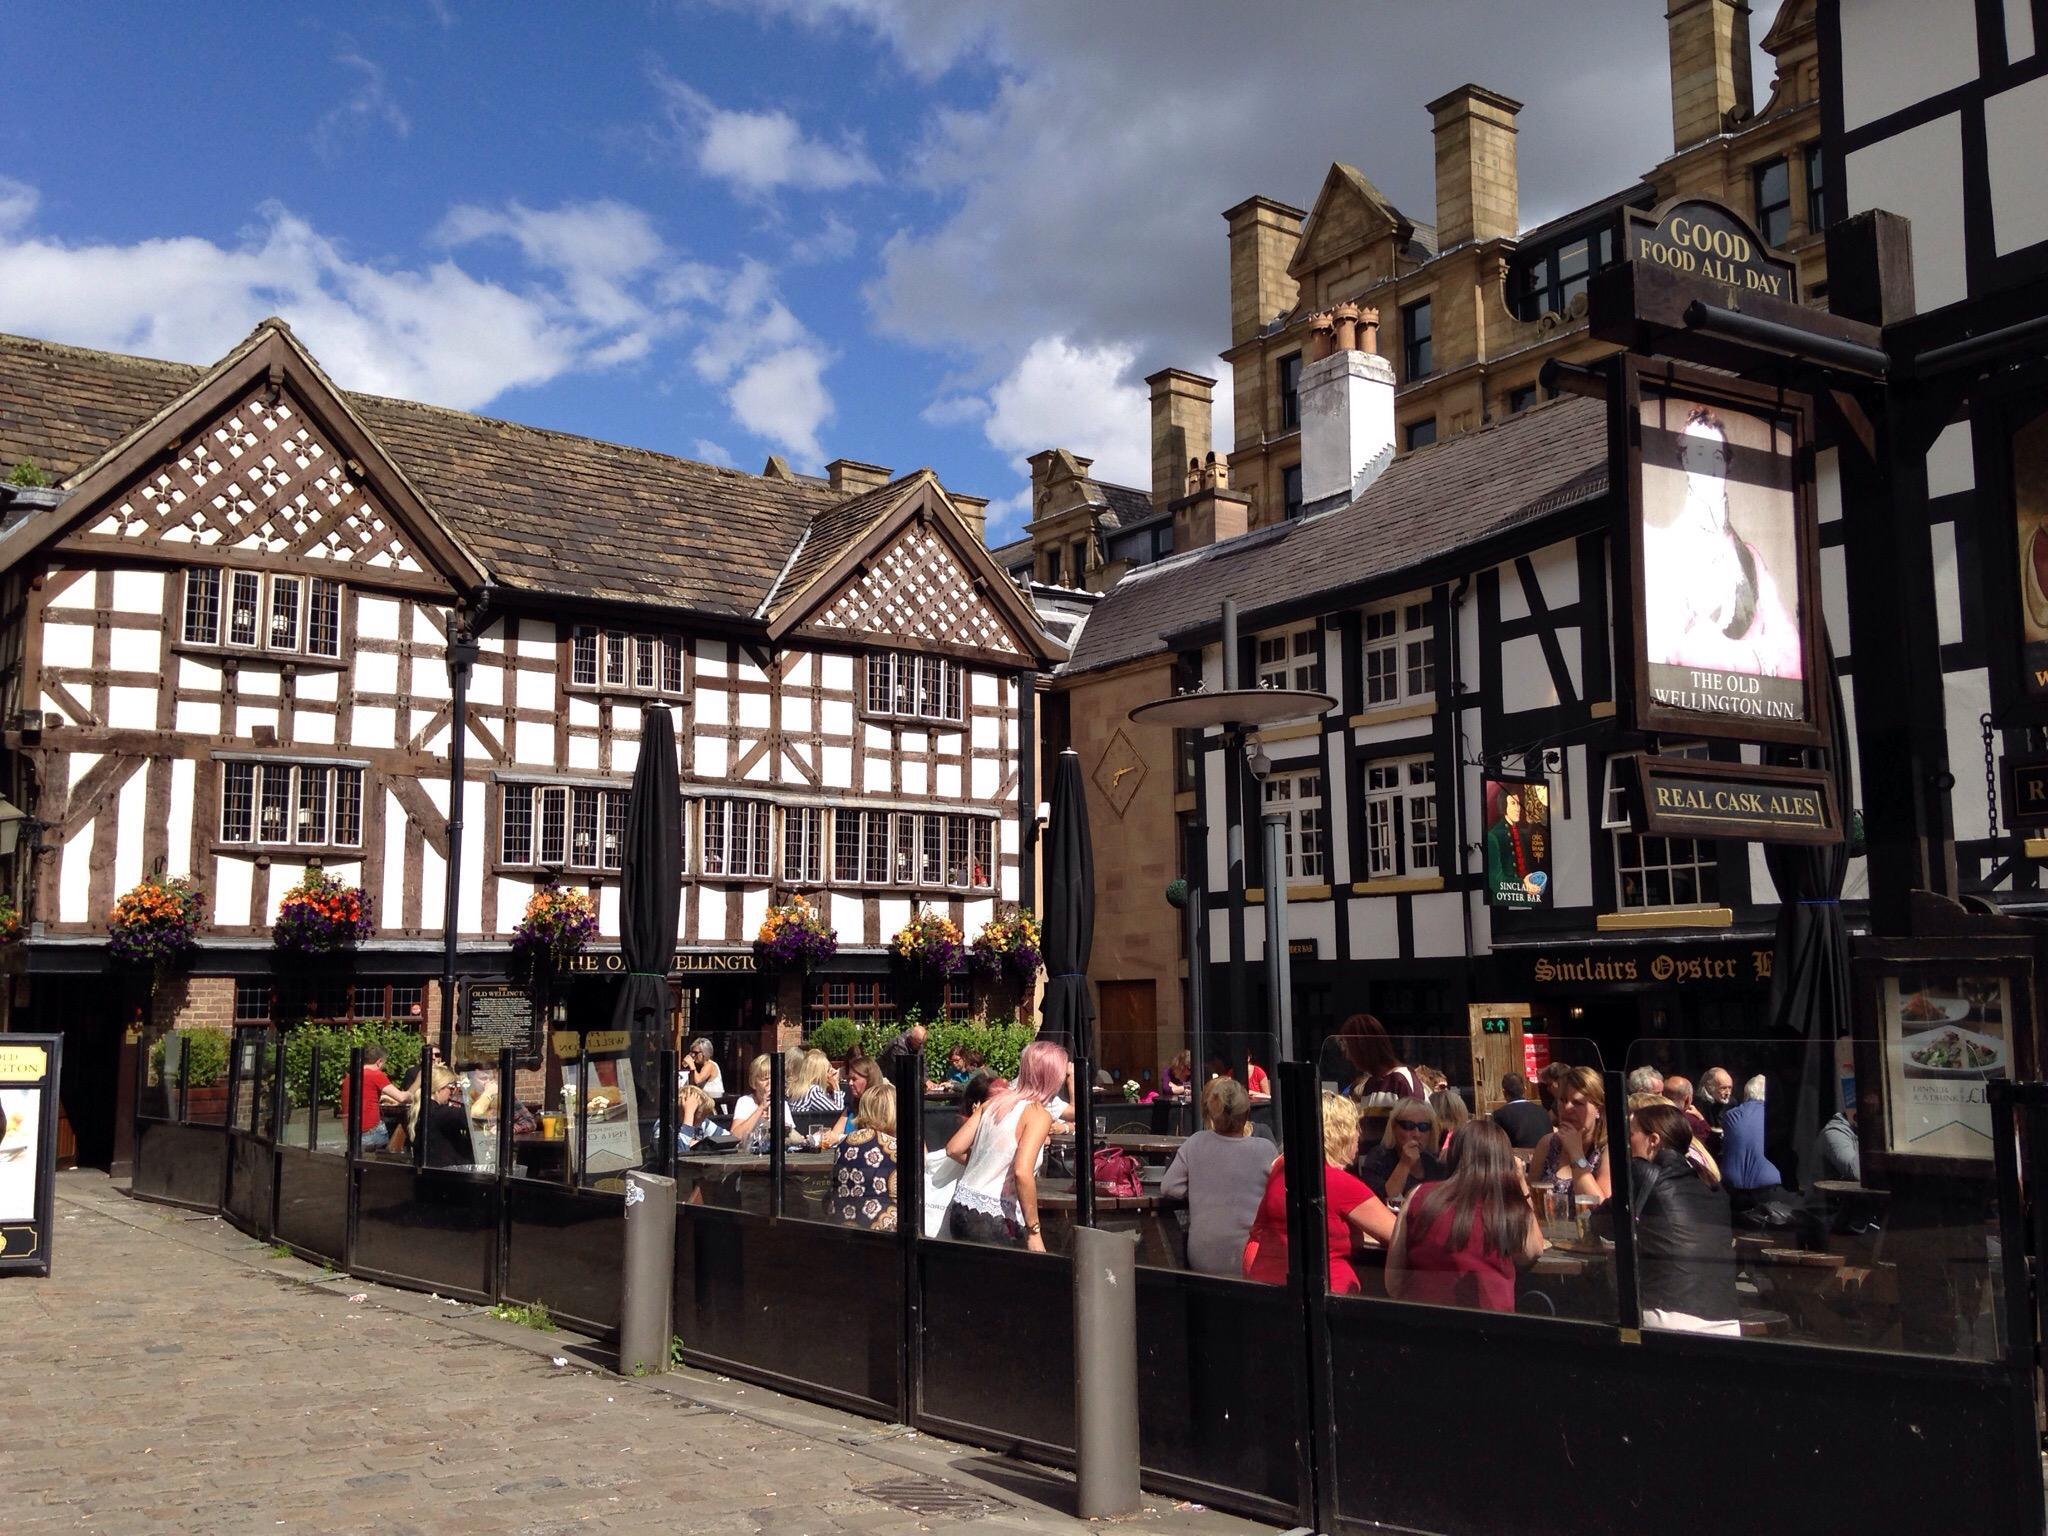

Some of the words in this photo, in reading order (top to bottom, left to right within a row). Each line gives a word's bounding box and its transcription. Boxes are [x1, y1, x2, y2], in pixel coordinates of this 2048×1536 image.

[1670, 217, 1750, 263] GOOD
[1640, 238, 1696, 272] FOOD
[1701, 257, 1741, 285] ALL
[1745, 268, 1781, 296] DAY
[1691, 671, 1723, 690] THE
[1726, 675, 1760, 694] OLD
[1655, 688, 1763, 716] WELLINGTON
[1767, 701, 1794, 718] INN
[1656, 787, 1712, 810] REAL
[1715, 791, 1765, 813] CASK
[1770, 796, 1815, 817] ALES
[1496, 892, 1525, 902] OYSTER
[1527, 893, 1542, 902] BAR
[1499, 881, 1536, 893] SINCLAI
[557, 955, 599, 971] THE
[670, 955, 764, 971] ELLINGTO
[1534, 956, 1638, 982] Sinclairs
[1650, 954, 1737, 984] Oyster
[488, 990, 531, 998] WELLINGT
